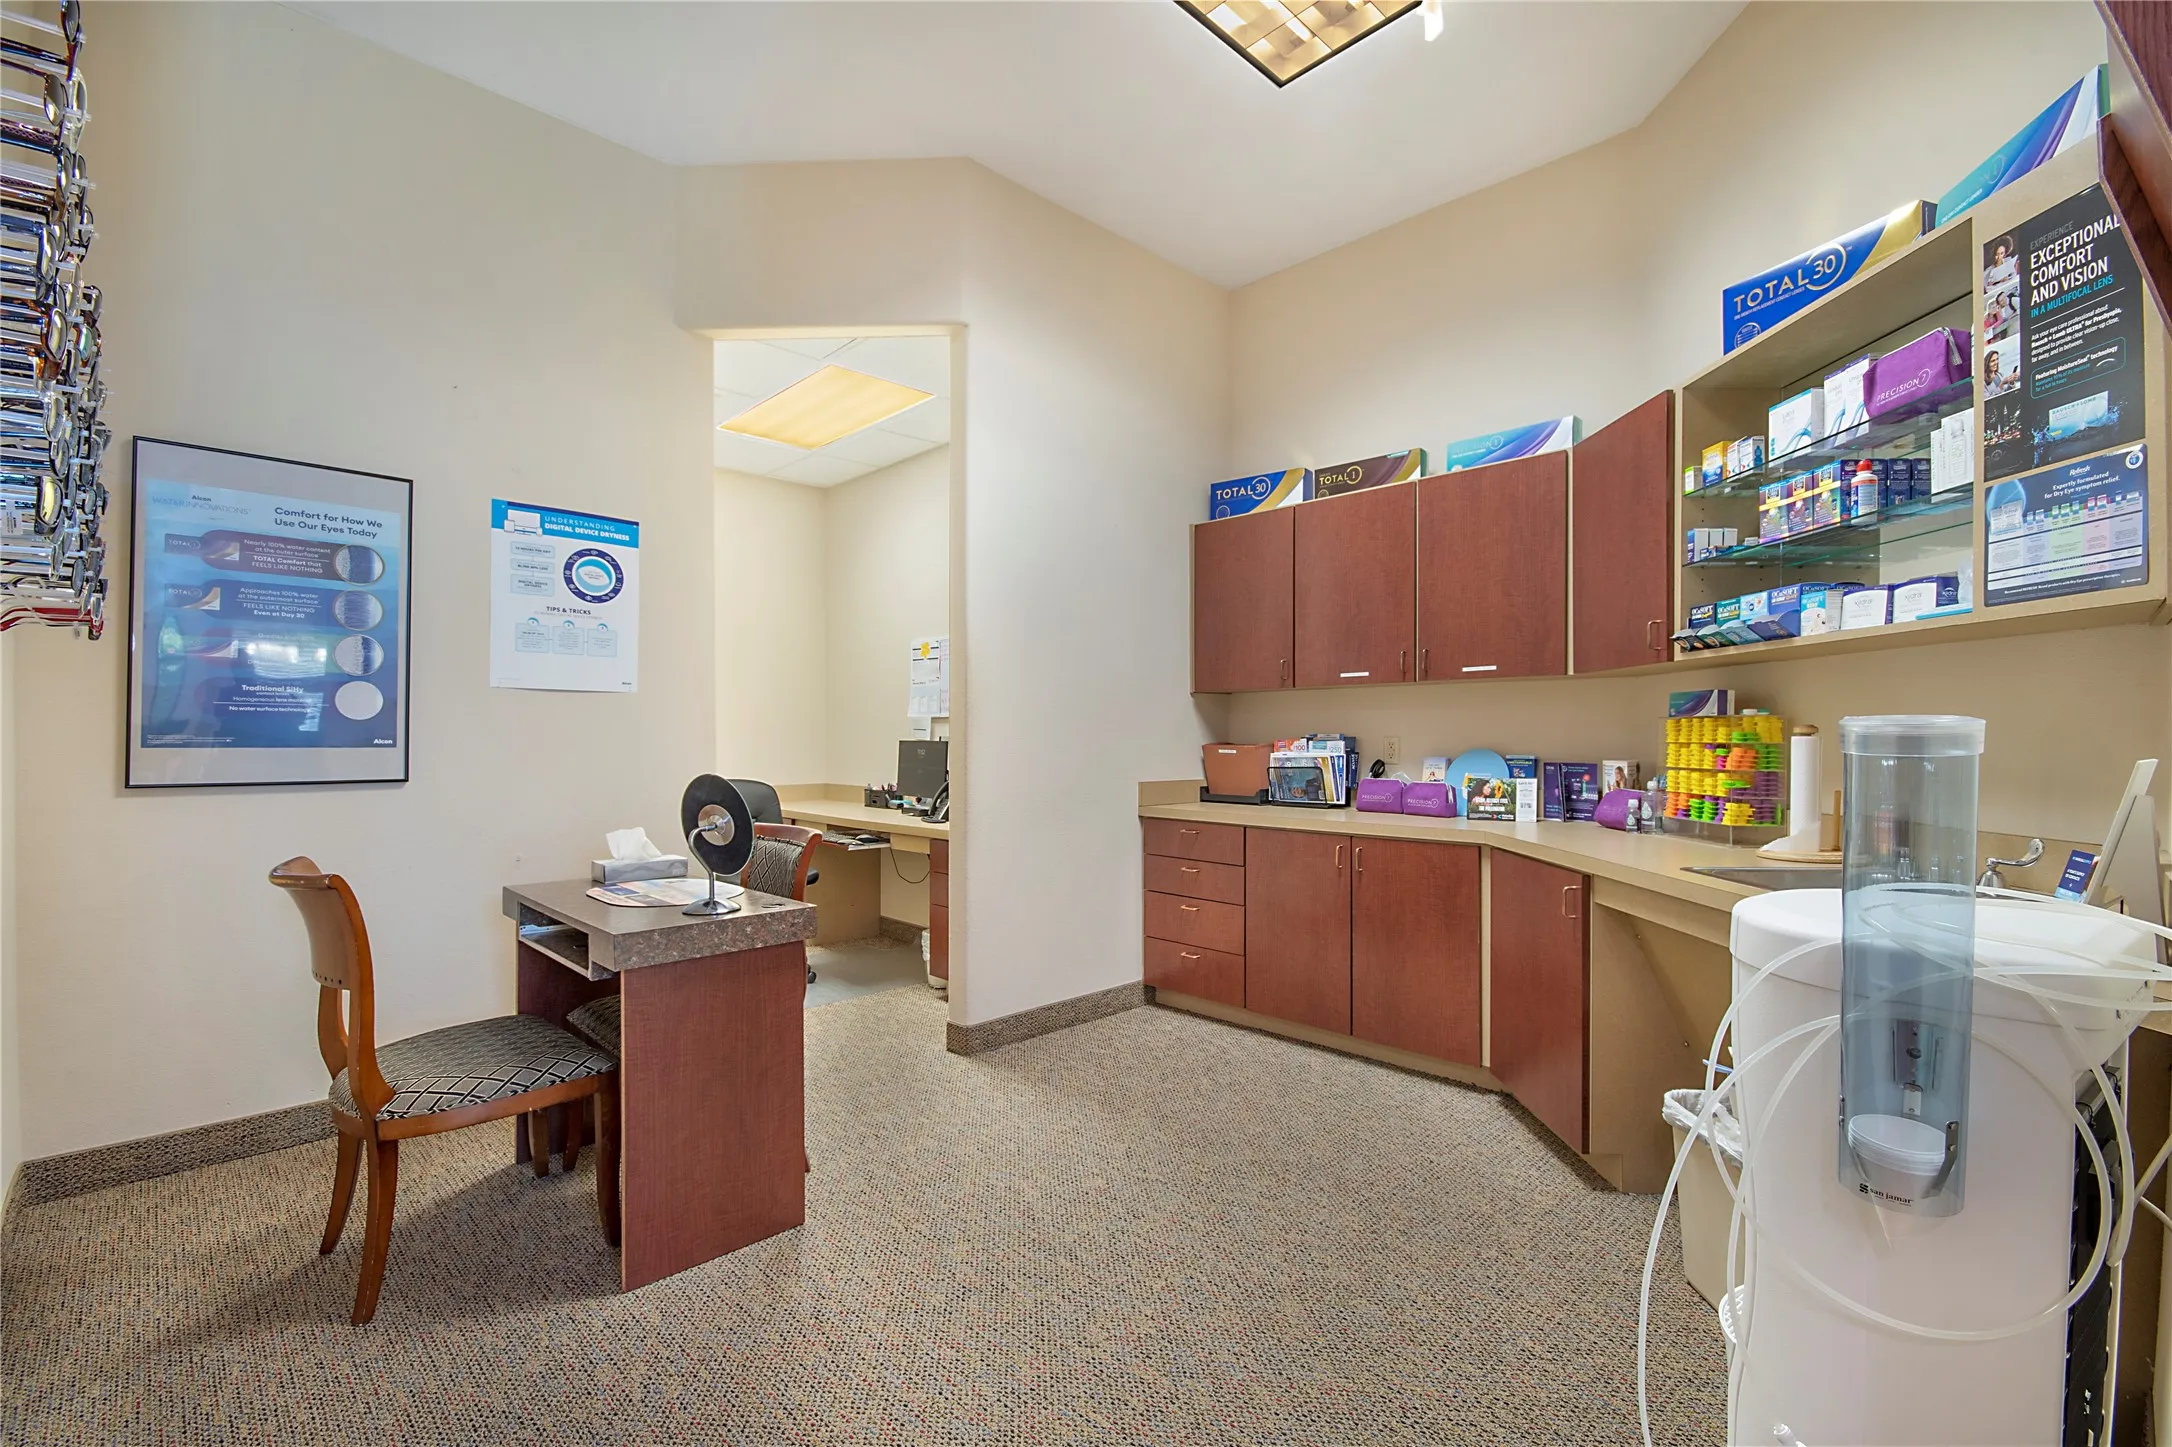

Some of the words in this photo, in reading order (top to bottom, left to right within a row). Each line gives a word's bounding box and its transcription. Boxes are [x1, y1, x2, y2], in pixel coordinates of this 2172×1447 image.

[2030, 220, 2074, 251] EXPERIENCE
[2030, 213, 2120, 270] EXCEPTIONAL
[2030, 243, 2095, 287] COMFORT
[1733, 268, 1809, 313] TOTAL
[1812, 254, 1836, 279] 30
[2030, 280, 2059, 307] AND
[2061, 256, 2108, 292] VISION
[2030, 307, 2039, 318] IN
[2040, 304, 2046, 314] A
[2047, 284, 2092, 311] MULTIFOCAL
[2093, 274, 2114, 291] LENS
[2031, 333, 2040, 341] Ask
[2039, 329, 2050, 338] your
[2049, 326, 2058, 334] eye
[2057, 322, 2068, 330] care
[2067, 309, 2095, 327] professional
[2094, 304, 2108, 315] about
[2031, 337, 2049, 348] Bausch
[2052, 330, 2066, 340] Lomb
[2031, 343, 2051, 356] designed
[2055, 335, 2072, 347] provide
[2072, 330, 2084, 339] clear
[2049, 347, 2059, 356] and
[2063, 339, 2084, 351] between.
[2035, 368, 2058, 380] Featuring
[2090, 345, 2118, 360] technology
[1876, 378, 1919, 402] PRECISION
[1319, 473, 1348, 485] TOTAL
[2069, 465, 2091, 477] Refresh
[2052, 479, 2076, 491] Expertly
[2076, 471, 2109, 484] formulated
[2053, 490, 2063, 498] Dry
[2064, 487, 2074, 496] Eye
[2075, 481, 2102, 493] symptom
[2102, 475, 2121, 486] relief.
[191, 494, 212, 502] Alcon
[1216, 485, 1253, 500] TOTAL
[1255, 482, 1266, 493] 30
[274, 506, 321, 520] Comfort
[323, 513, 339, 522] for
[341, 516, 364, 526] How
[366, 519, 383, 529] We
[544, 516, 615, 532] UNDERSTANDING
[274, 517, 296, 528] Use
[297, 520, 319, 531] Our
[320, 523, 345, 534] Eyes
[347, 527, 378, 539] Today
[544, 522, 574, 533] DIGITAL
[574, 527, 599, 537] DEVICE
[599, 531, 630, 541] DRYNESS
[244, 539, 267, 547] Nearly
[267, 541, 285, 549] 100%
[251, 561, 272, 569] FEELS
[289, 565, 323, 574] NOTHING
[277, 558, 306, 566] Comfort
[240, 587, 280, 596] Approaches
[281, 590, 300, 598] 100%
[253, 609, 271, 617] Even
[546, 605, 561, 613] TIPS
[569, 608, 592, 616] TRICKS
[241, 684, 285, 692] Traditional
[285, 686, 304, 694] SiHy
[1361, 793, 1386, 801] PRECISION
[1407, 798, 1433, 806] PRECISION
[1869, 1188, 1884, 1197] san
[1885, 1192, 1911, 1204] jamar
